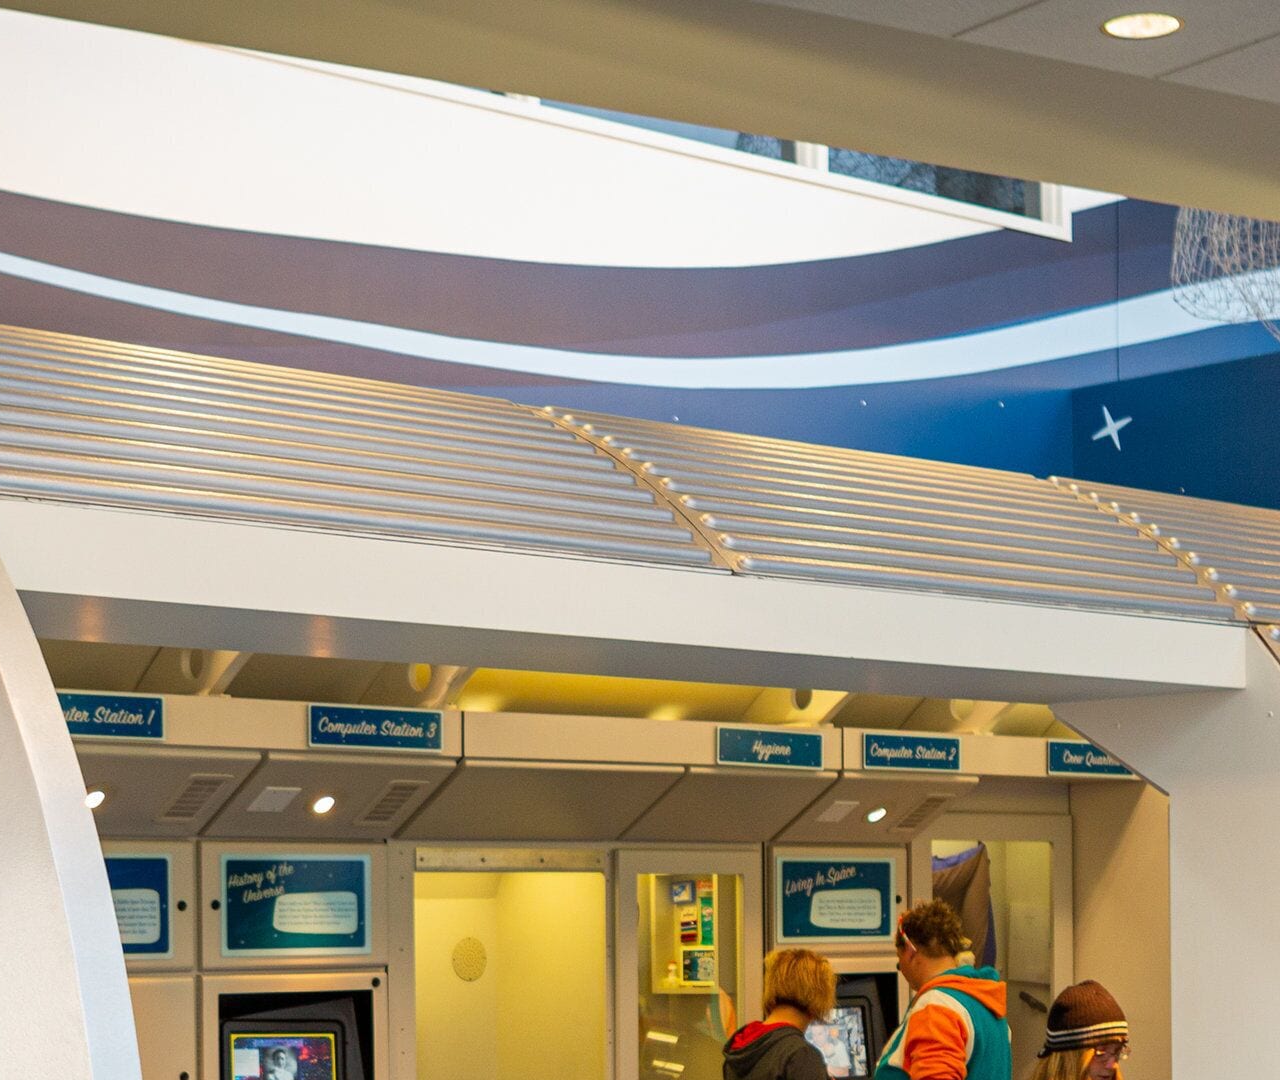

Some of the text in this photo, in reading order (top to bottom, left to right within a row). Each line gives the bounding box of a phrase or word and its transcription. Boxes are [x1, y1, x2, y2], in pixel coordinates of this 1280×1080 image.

[63, 706, 90, 723] uter
[93, 706, 145, 725] Station
[318, 716, 437, 738] Computer Station 3
[752, 740, 792, 761] Hygiene
[870, 743, 957, 761] Computer Station 2
[1063, 749, 1084, 764] Crew
[228, 861, 295, 889] History of the
[785, 878, 814, 897] Living
[827, 865, 857, 886] Space
